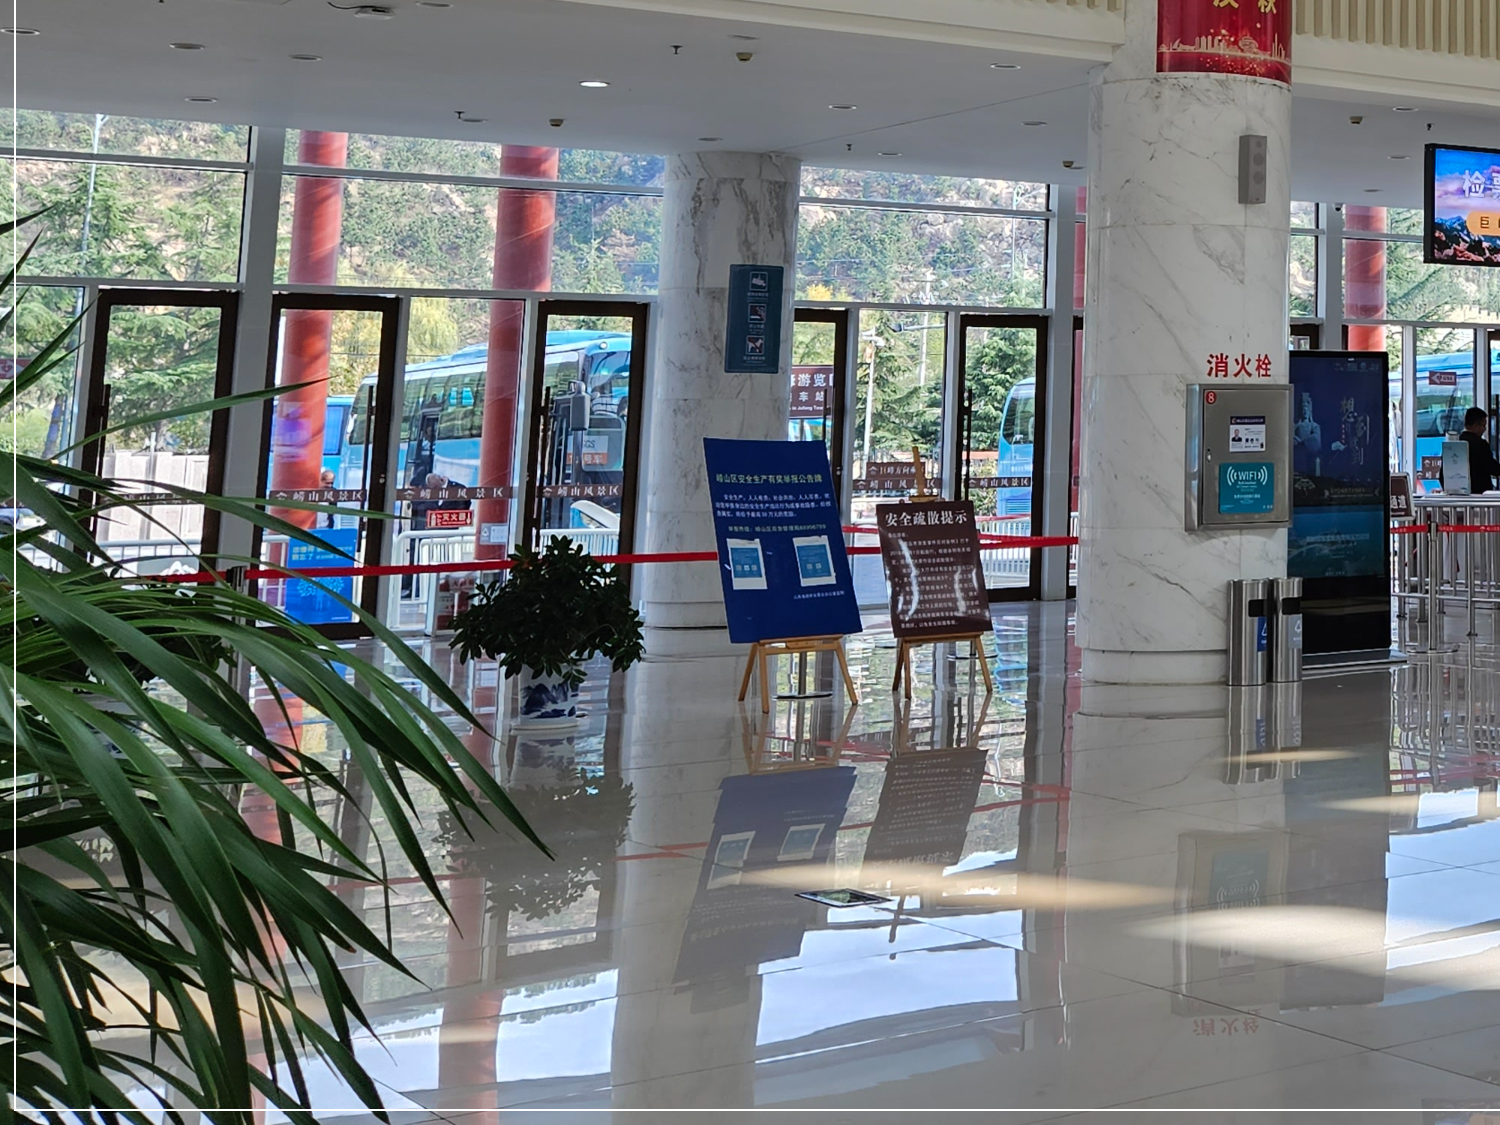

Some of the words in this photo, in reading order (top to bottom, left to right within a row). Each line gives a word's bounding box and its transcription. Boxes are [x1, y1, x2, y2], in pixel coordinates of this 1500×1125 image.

[1206, 352, 1272, 378] 消火栓
[1207, 392, 1215, 403] 8
[979, 477, 1029, 487] 崂山风景区
[292, 489, 364, 501] 崂山风景区
[420, 487, 504, 499] 崂山风景区
[557, 485, 619, 497] 崂山风景区
[886, 510, 968, 527] 安全疏散提示
